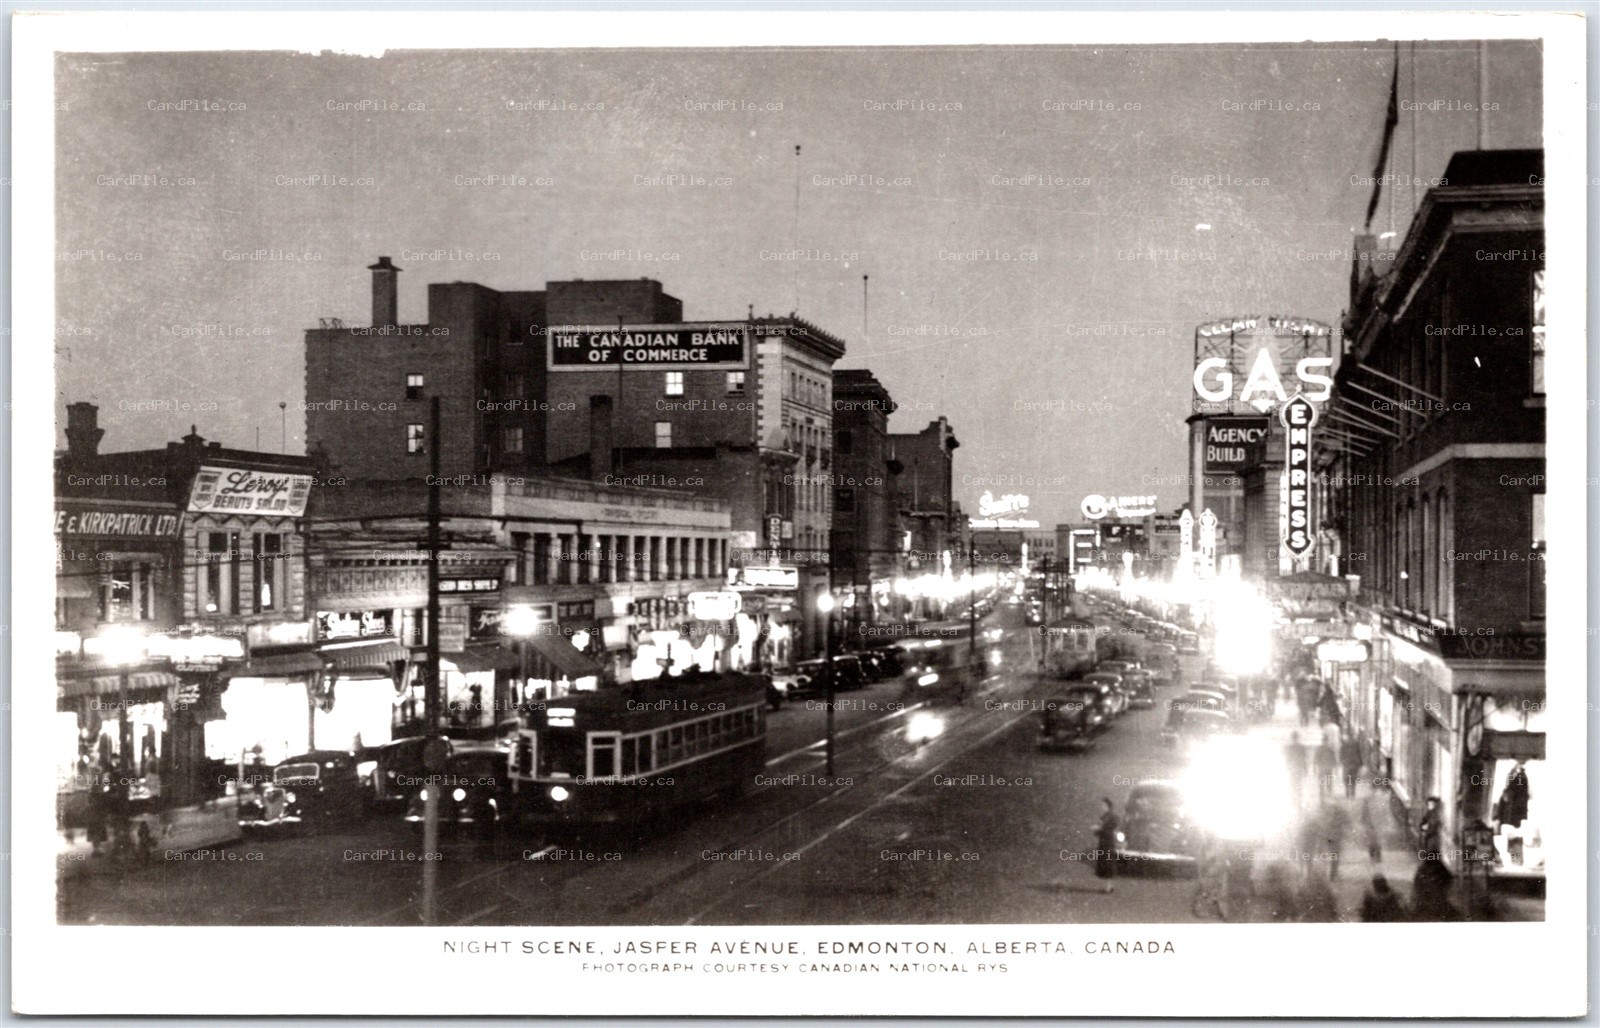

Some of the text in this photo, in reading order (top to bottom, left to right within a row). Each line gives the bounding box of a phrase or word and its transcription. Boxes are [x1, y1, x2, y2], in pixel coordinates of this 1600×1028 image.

[556, 333, 739, 348] THE CANADIAN BANK
[588, 349, 708, 362] OF COMMERCE
[1193, 347, 1334, 402] GAS
[1208, 425, 1268, 443] AGENCY
[1206, 444, 1245, 463] BUILD
[1290, 404, 1307, 548] EMPRESS
[213, 495, 253, 509] BEAUTY
[54, 511, 67, 533] E
[66, 516, 77, 534] &
[78, 511, 153, 537] KIRKPATRICK
[1454, 637, 1546, 656] JOHNS
